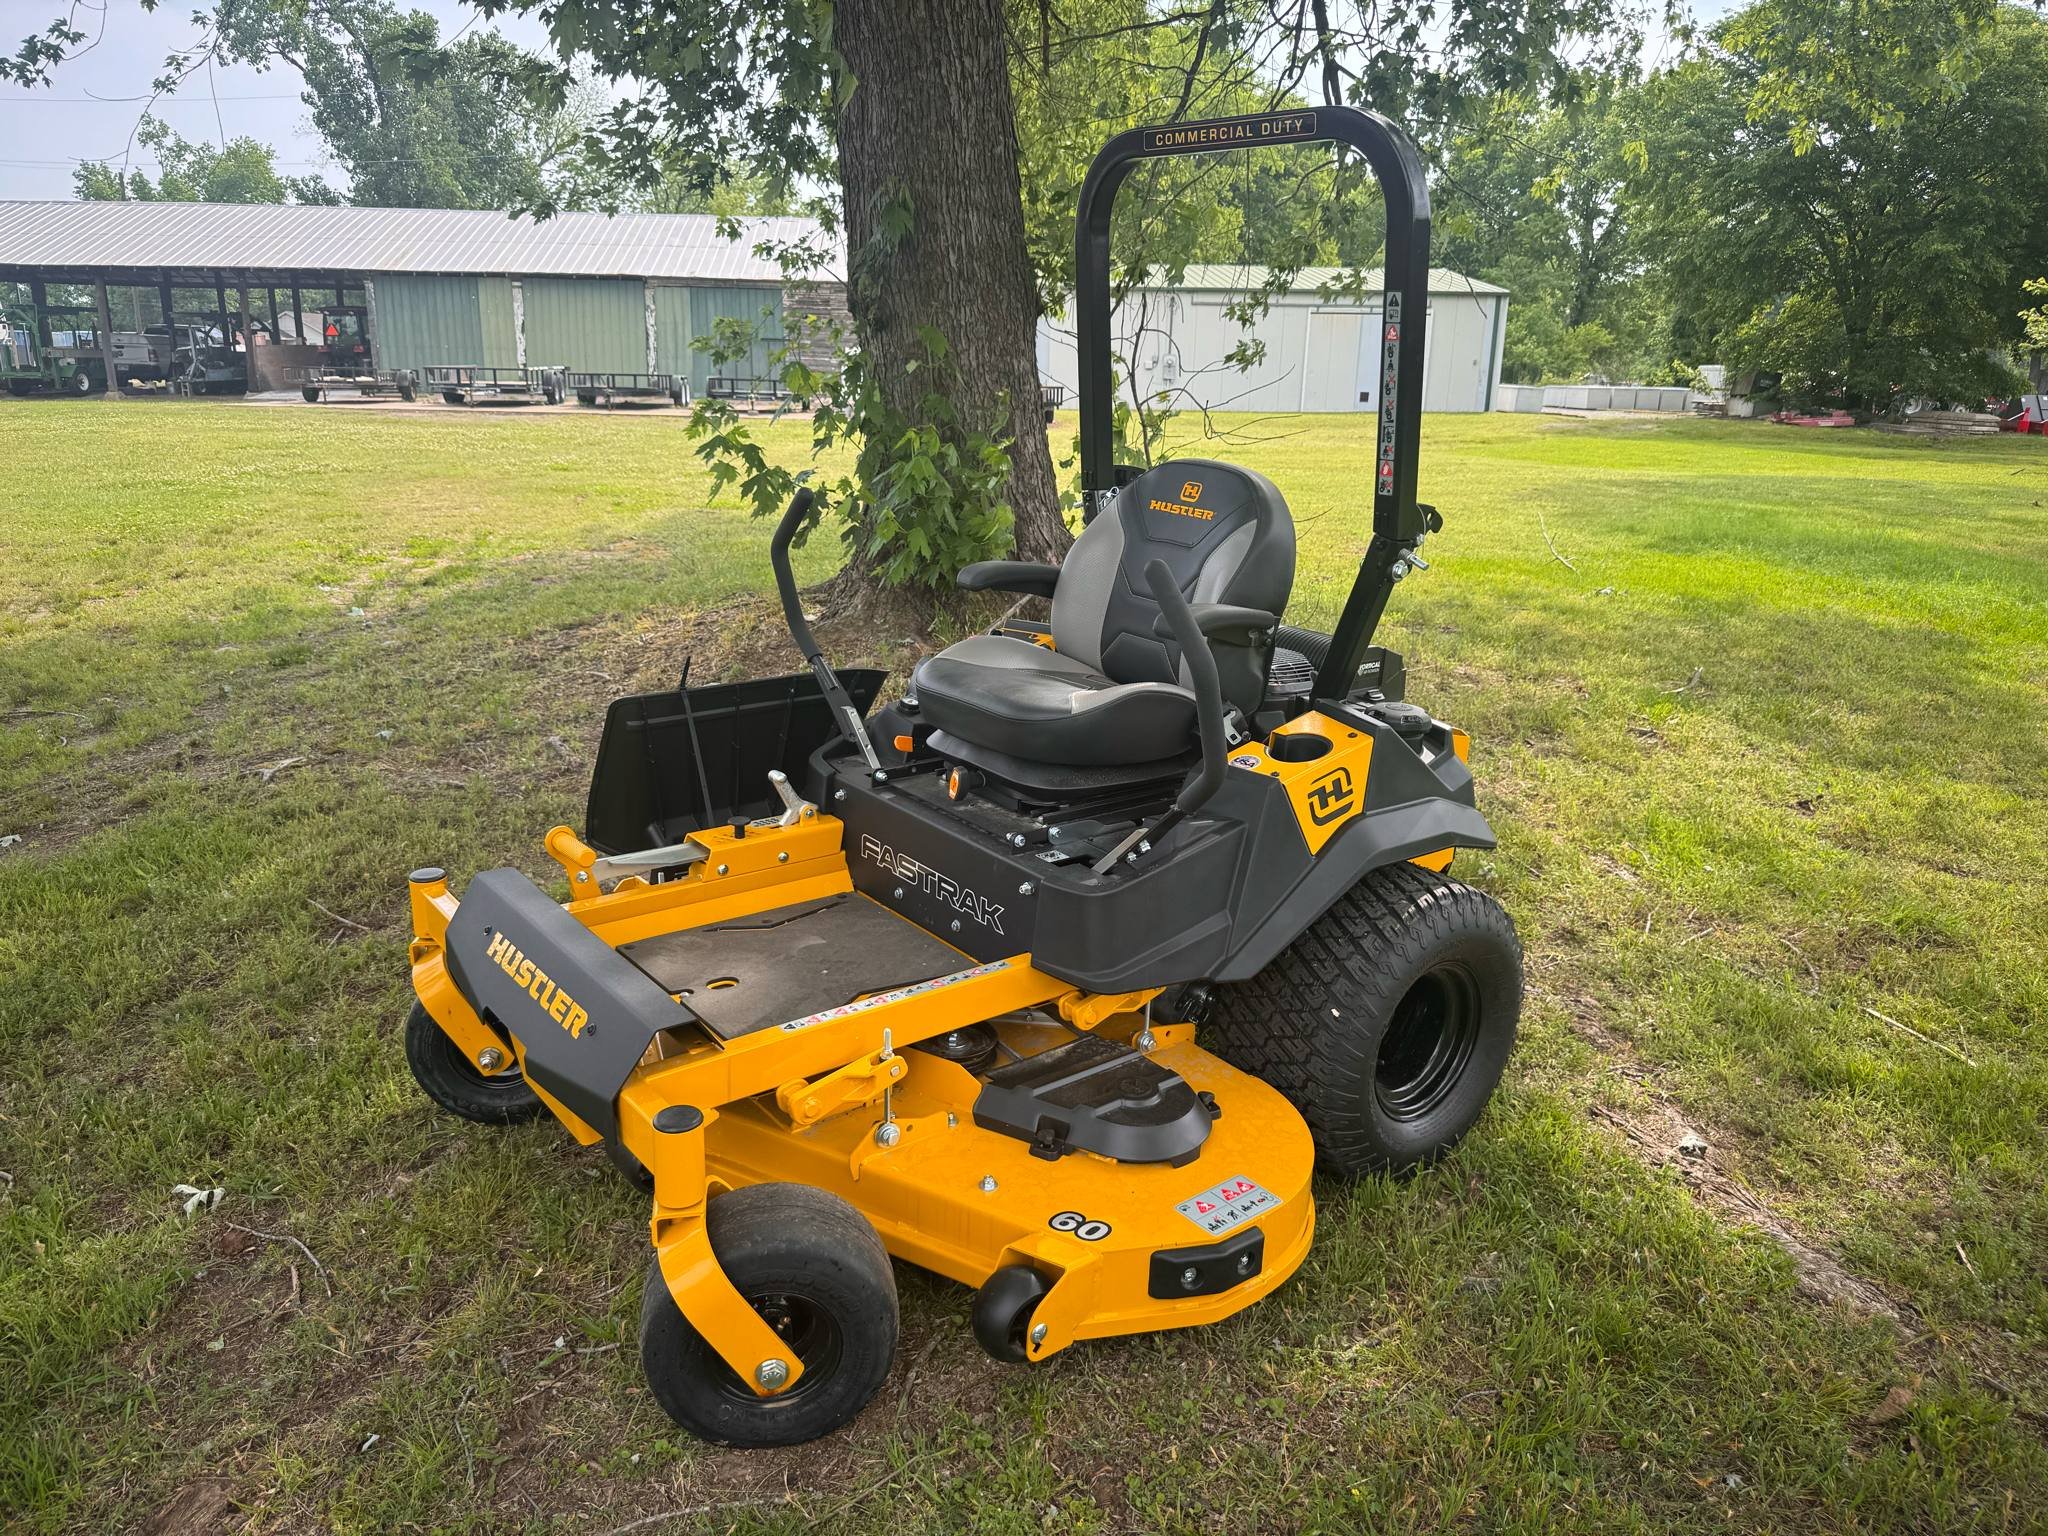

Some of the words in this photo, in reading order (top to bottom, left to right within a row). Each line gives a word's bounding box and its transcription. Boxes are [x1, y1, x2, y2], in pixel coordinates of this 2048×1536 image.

[1156, 125, 1254, 146] COMMERCIAL
[1261, 119, 1304, 135] DUTY
[1149, 500, 1215, 520] HUSTLER
[861, 834, 1005, 936] FASTRAK
[486, 931, 589, 1040] HUSTLER
[1048, 1210, 1112, 1241] 60
